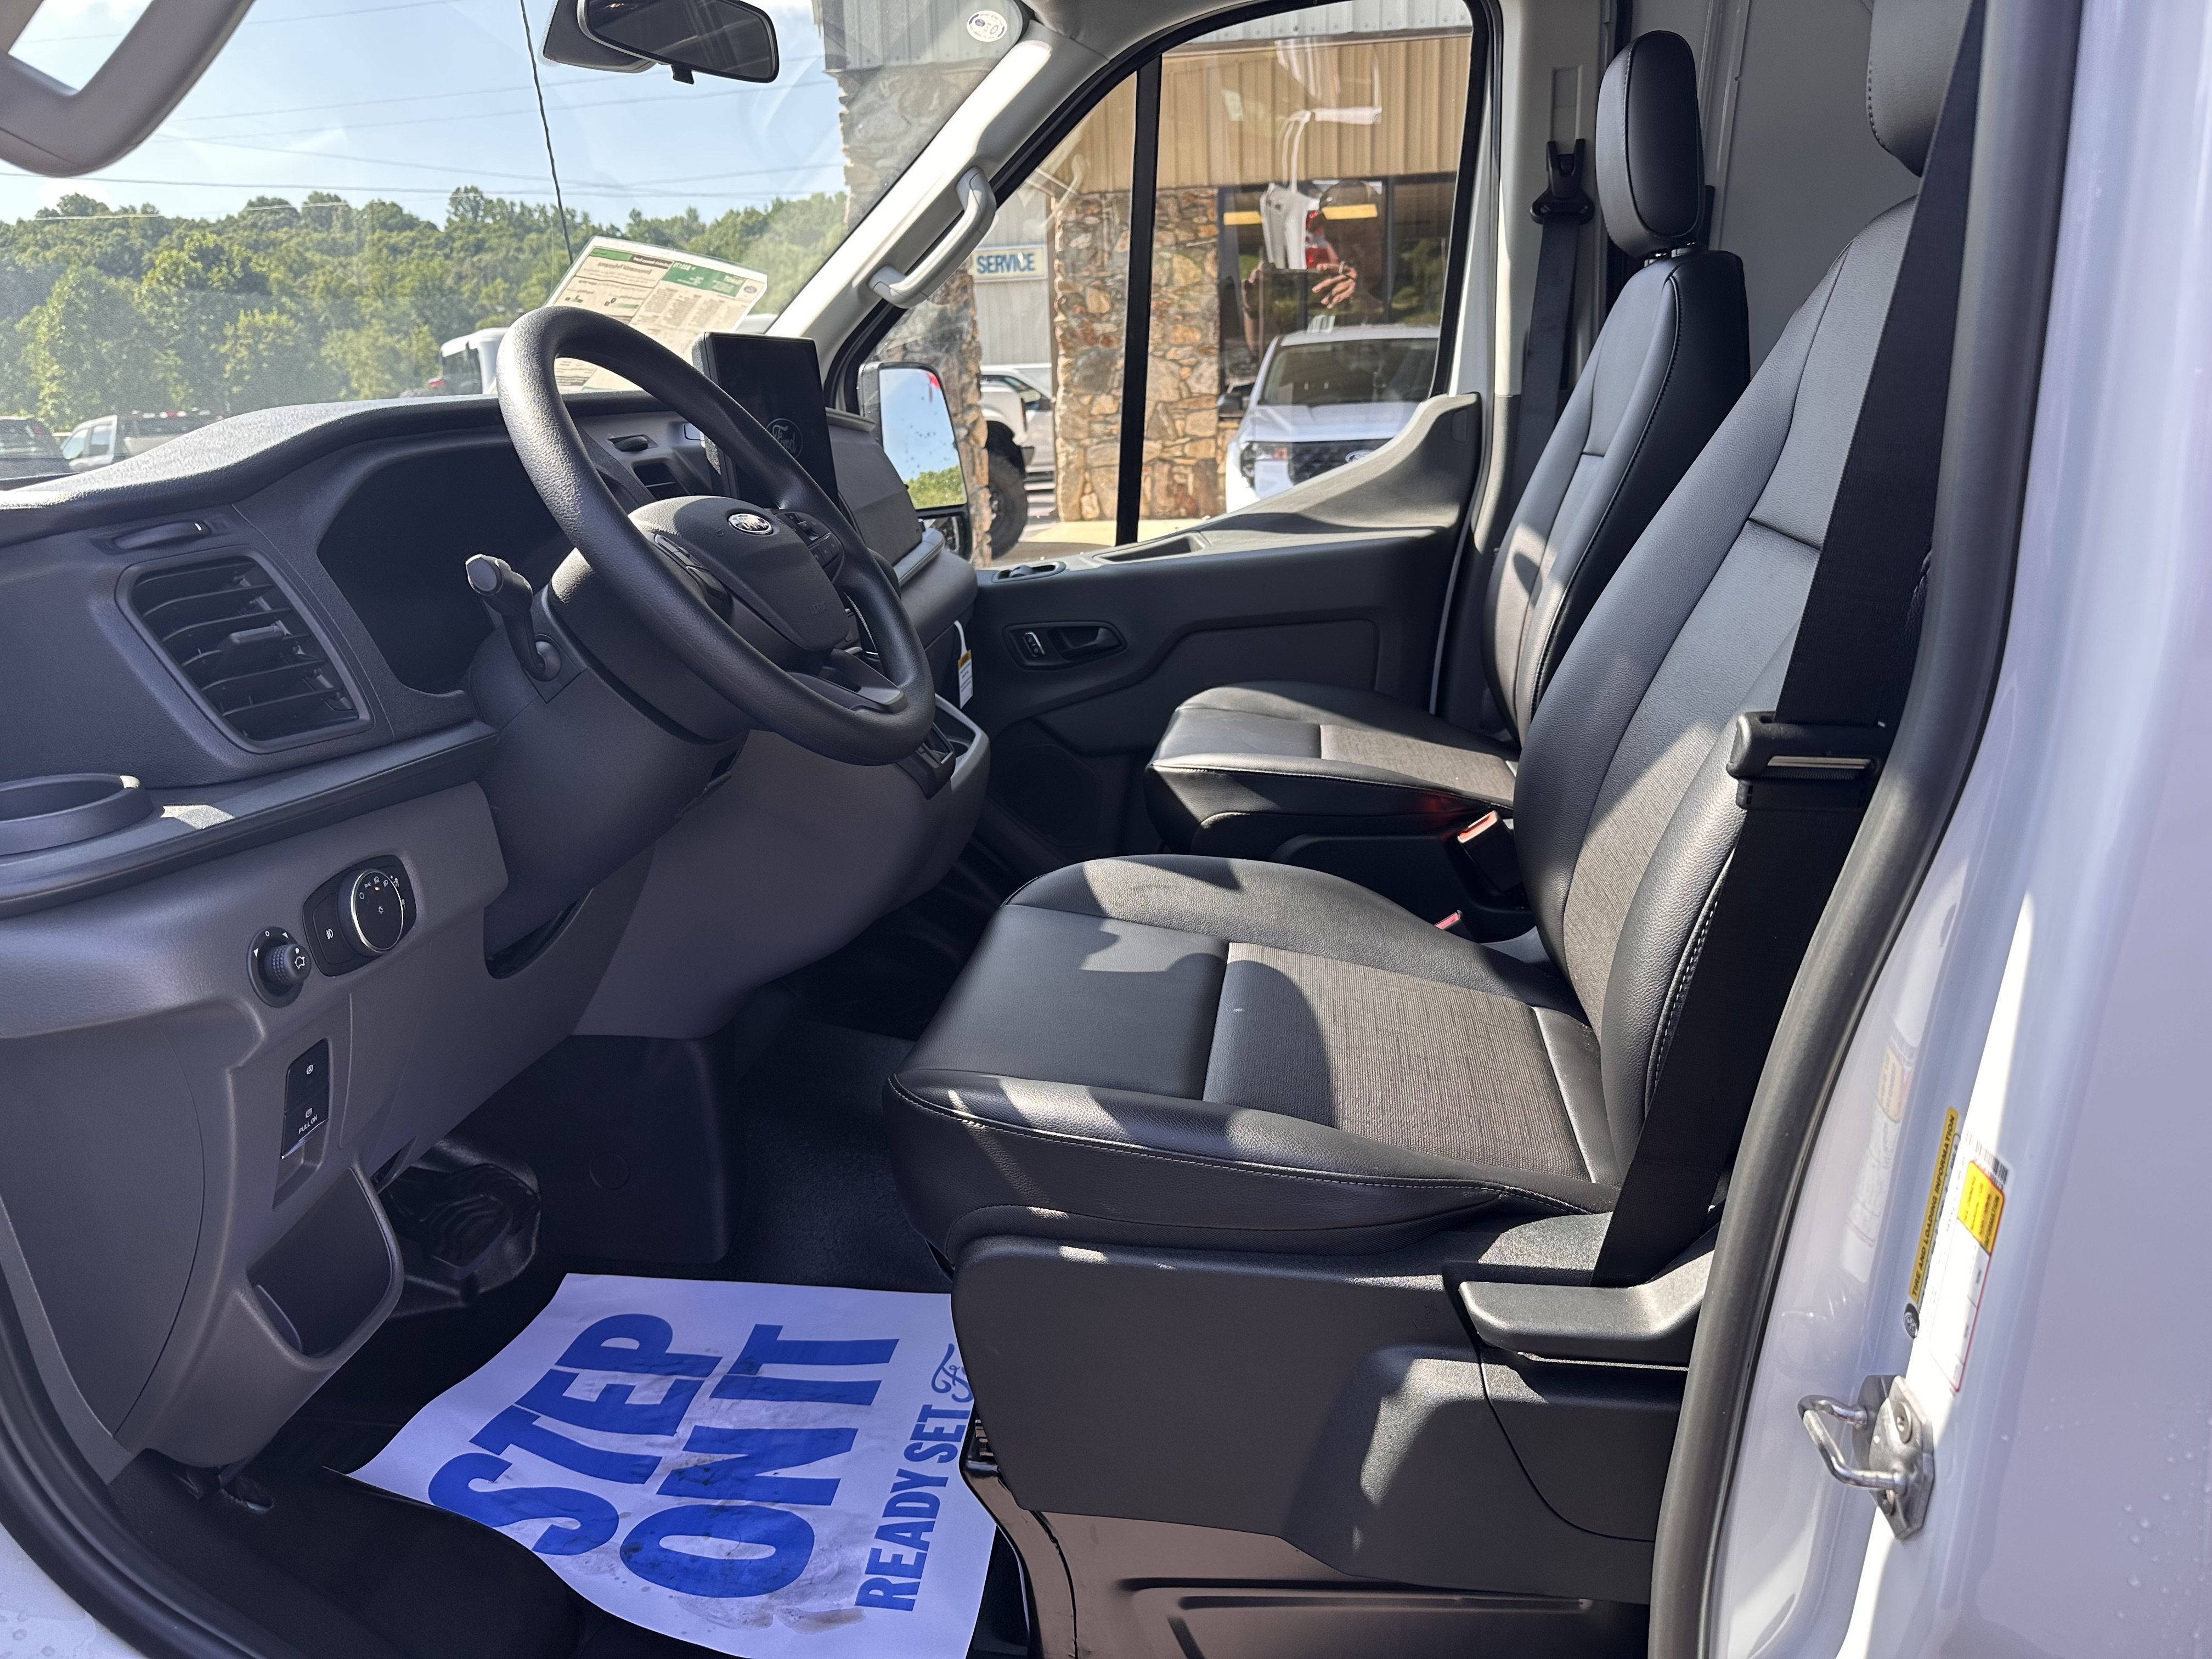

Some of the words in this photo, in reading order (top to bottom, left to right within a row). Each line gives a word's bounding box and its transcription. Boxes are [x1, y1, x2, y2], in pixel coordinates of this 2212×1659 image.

[977, 252, 1035, 274] SERVICE
[298, 1121, 311, 1135] PULL
[311, 1114, 318, 1124] ON
[1912, 1270, 1922, 1296] TIRE
[1918, 1246, 1927, 1271] AND
[1923, 1195, 1938, 1245] LOADING
[1934, 1114, 1955, 1194] INFORMATION
[428, 1313, 723, 1556] STEP
[709, 1324, 900, 1406] IT
[620, 1426, 858, 1599] ON
[854, 1468, 949, 1612] READY
[904, 1403, 971, 1464] SET
